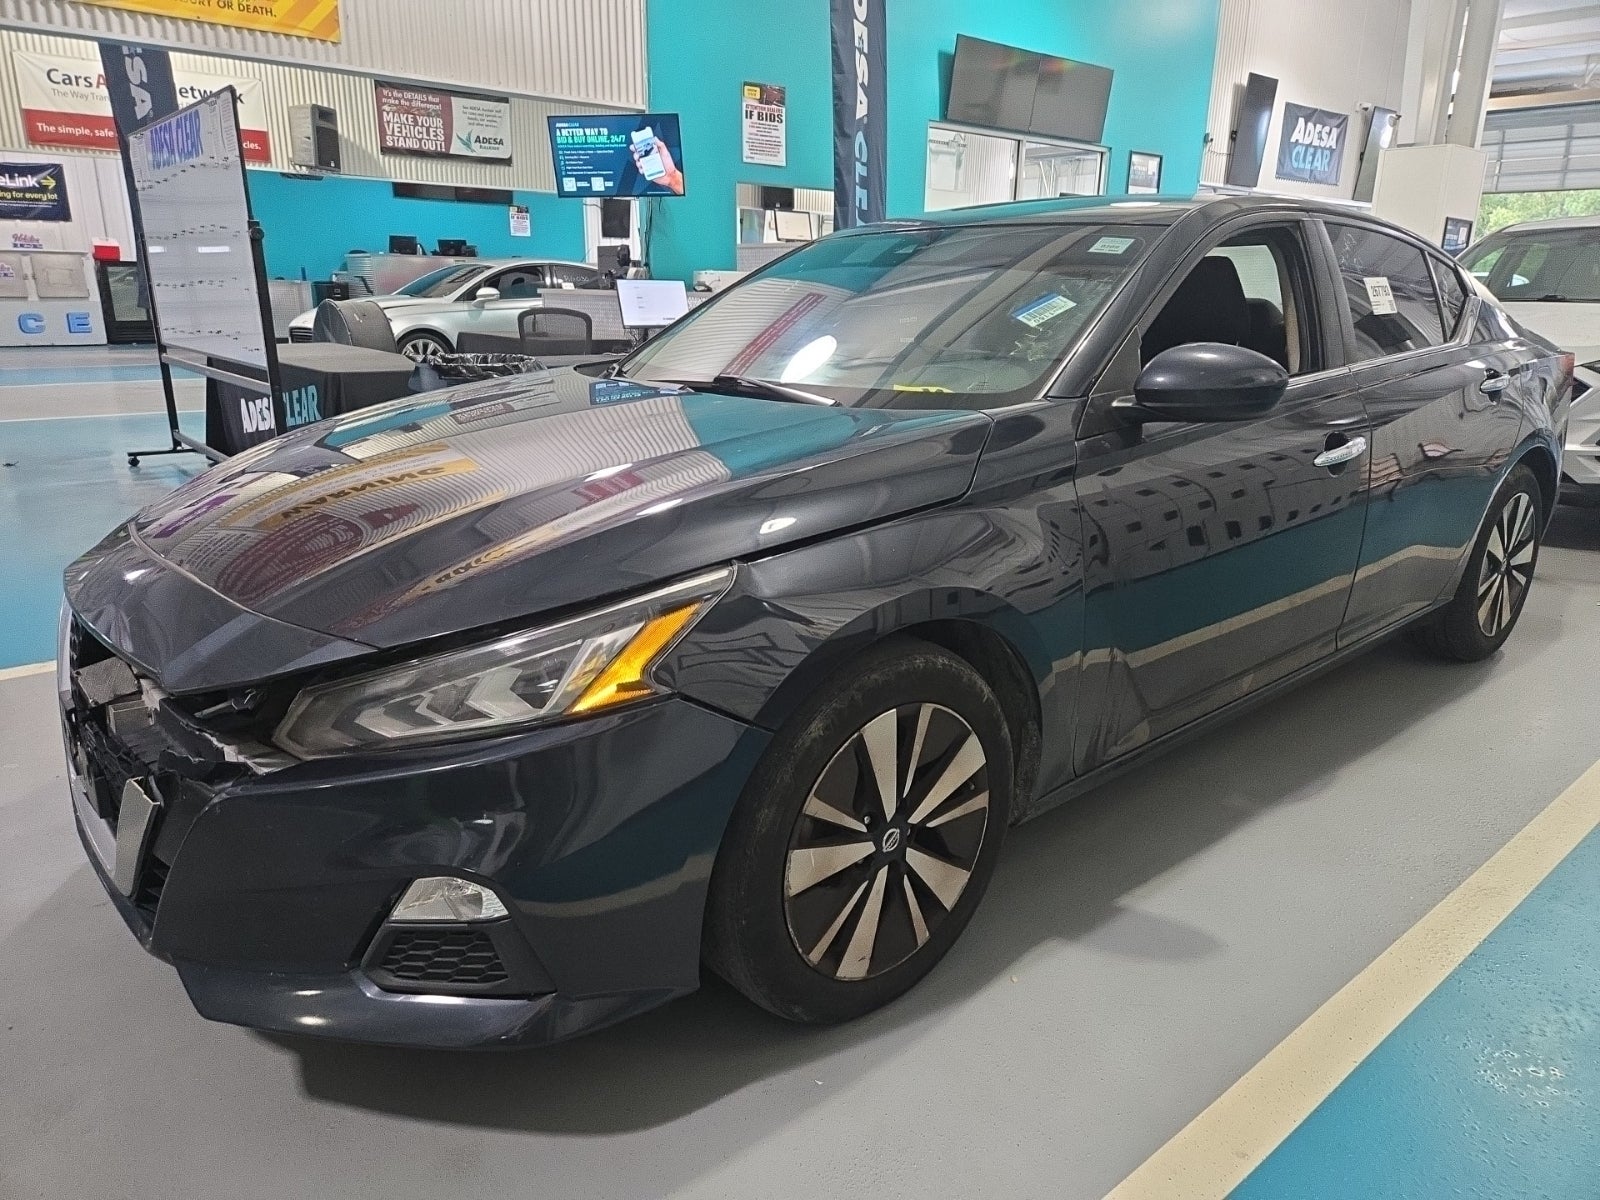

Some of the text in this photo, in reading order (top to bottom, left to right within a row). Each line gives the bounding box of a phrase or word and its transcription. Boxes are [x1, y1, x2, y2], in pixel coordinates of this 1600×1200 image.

[217, 0, 234, 10] OR
[238, 3, 277, 17] DEATH.
[122, 45, 153, 120] SA
[51, 88, 69, 97] The
[70, 90, 89, 101] Way
[178, 85, 245, 104] etwk
[382, 97, 399, 105] make
[400, 98, 410, 106] the
[403, 92, 427, 101] DETAILS
[383, 111, 444, 129] MAKE YOUR
[745, 110, 783, 124] IF BIDS
[36, 122, 56, 132] The
[58, 125, 93, 136] simple,
[94, 128, 114, 138] safe
[384, 122, 445, 141] VEHICLES
[584, 128, 598, 136] WAY
[599, 127, 608, 136] TO
[1289, 117, 1338, 149] ADESA
[386, 135, 446, 151] STAND OUT!
[474, 135, 504, 146] ADESA
[610, 135, 626, 143] 24/7
[1291, 145, 1332, 172] CLEAR
[25, 193, 47, 201] every
